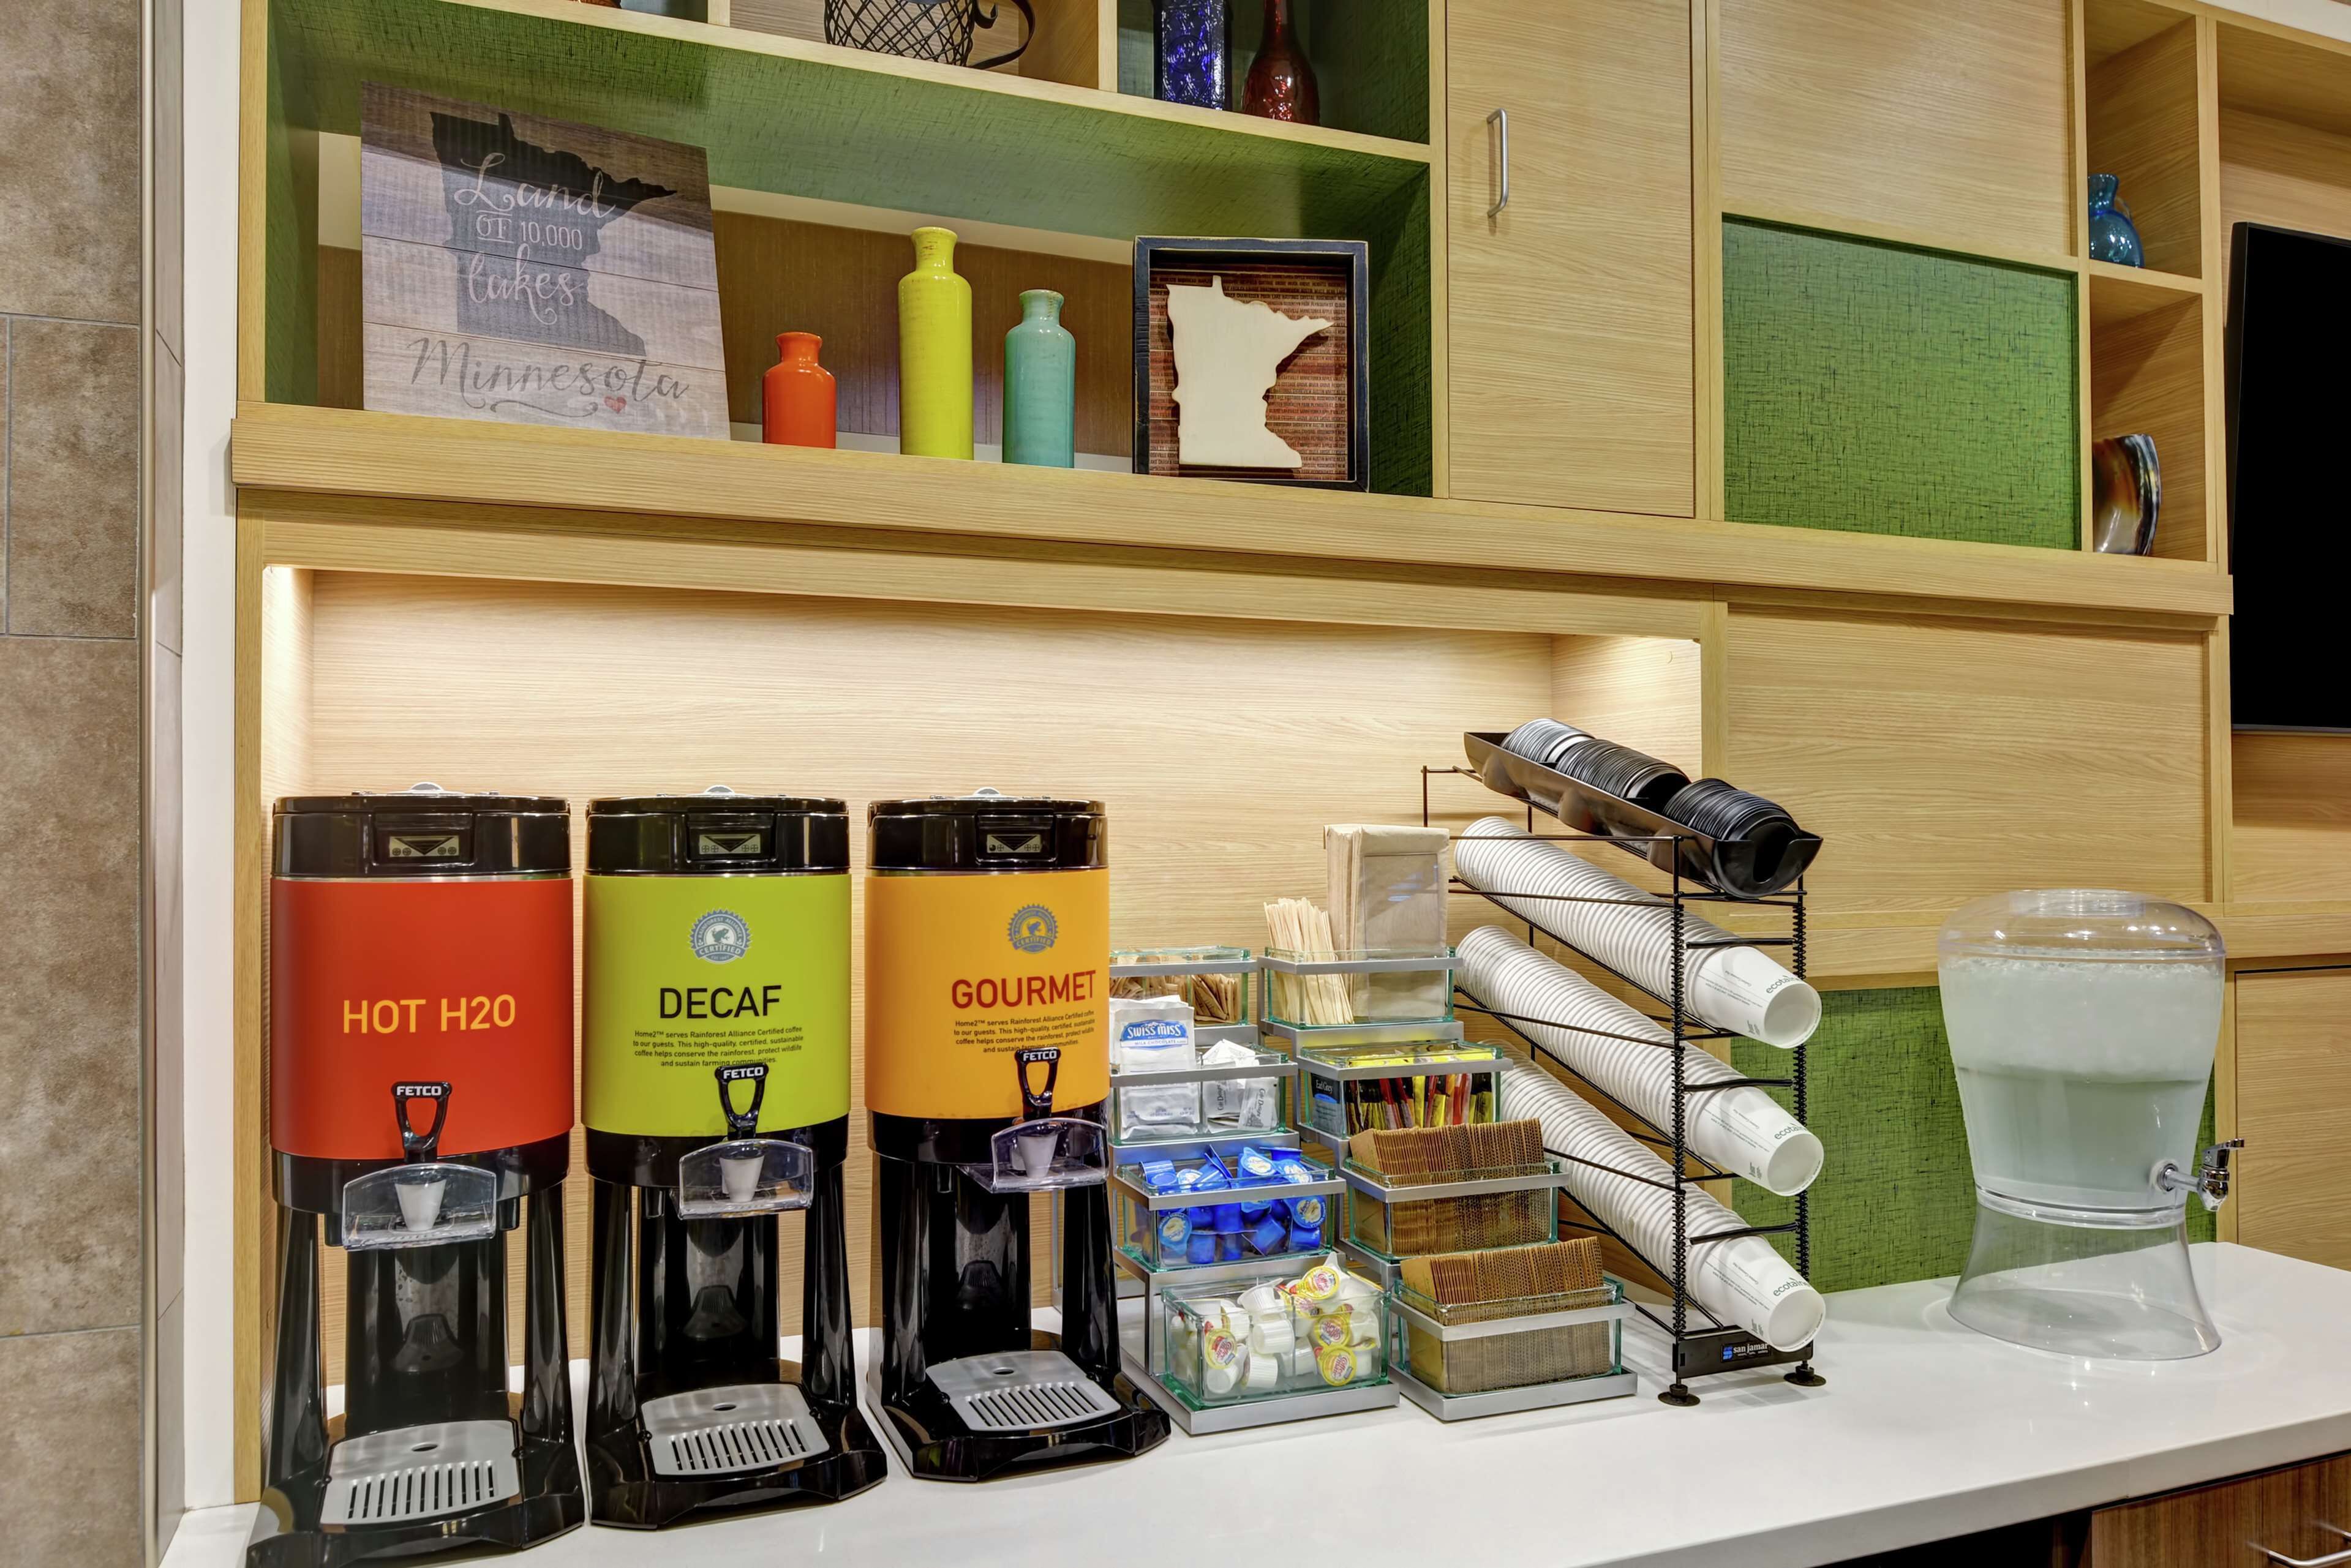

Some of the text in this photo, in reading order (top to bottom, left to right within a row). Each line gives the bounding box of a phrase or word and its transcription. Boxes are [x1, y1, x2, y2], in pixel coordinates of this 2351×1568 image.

[454, 152, 615, 219] Land
[521, 221, 582, 250] 10,000
[468, 243, 584, 325] lakes
[407, 337, 690, 409] Minnesota
[699, 945, 741, 955] CERTIFIED
[952, 970, 1096, 1009] GOURMET
[660, 985, 782, 1019] DECAF
[343, 999, 426, 1034] HOT
[758, 1027, 784, 1036] Certified
[770, 1035, 803, 1044] sustainable
[758, 1047, 780, 1056] protect
[781, 1044, 802, 1052] wildlife
[1023, 1050, 1057, 1061] FETCO
[723, 1067, 764, 1079] FETCO
[396, 1086, 443, 1097] FETCO
[1747, 1343, 1768, 1353] jamar
